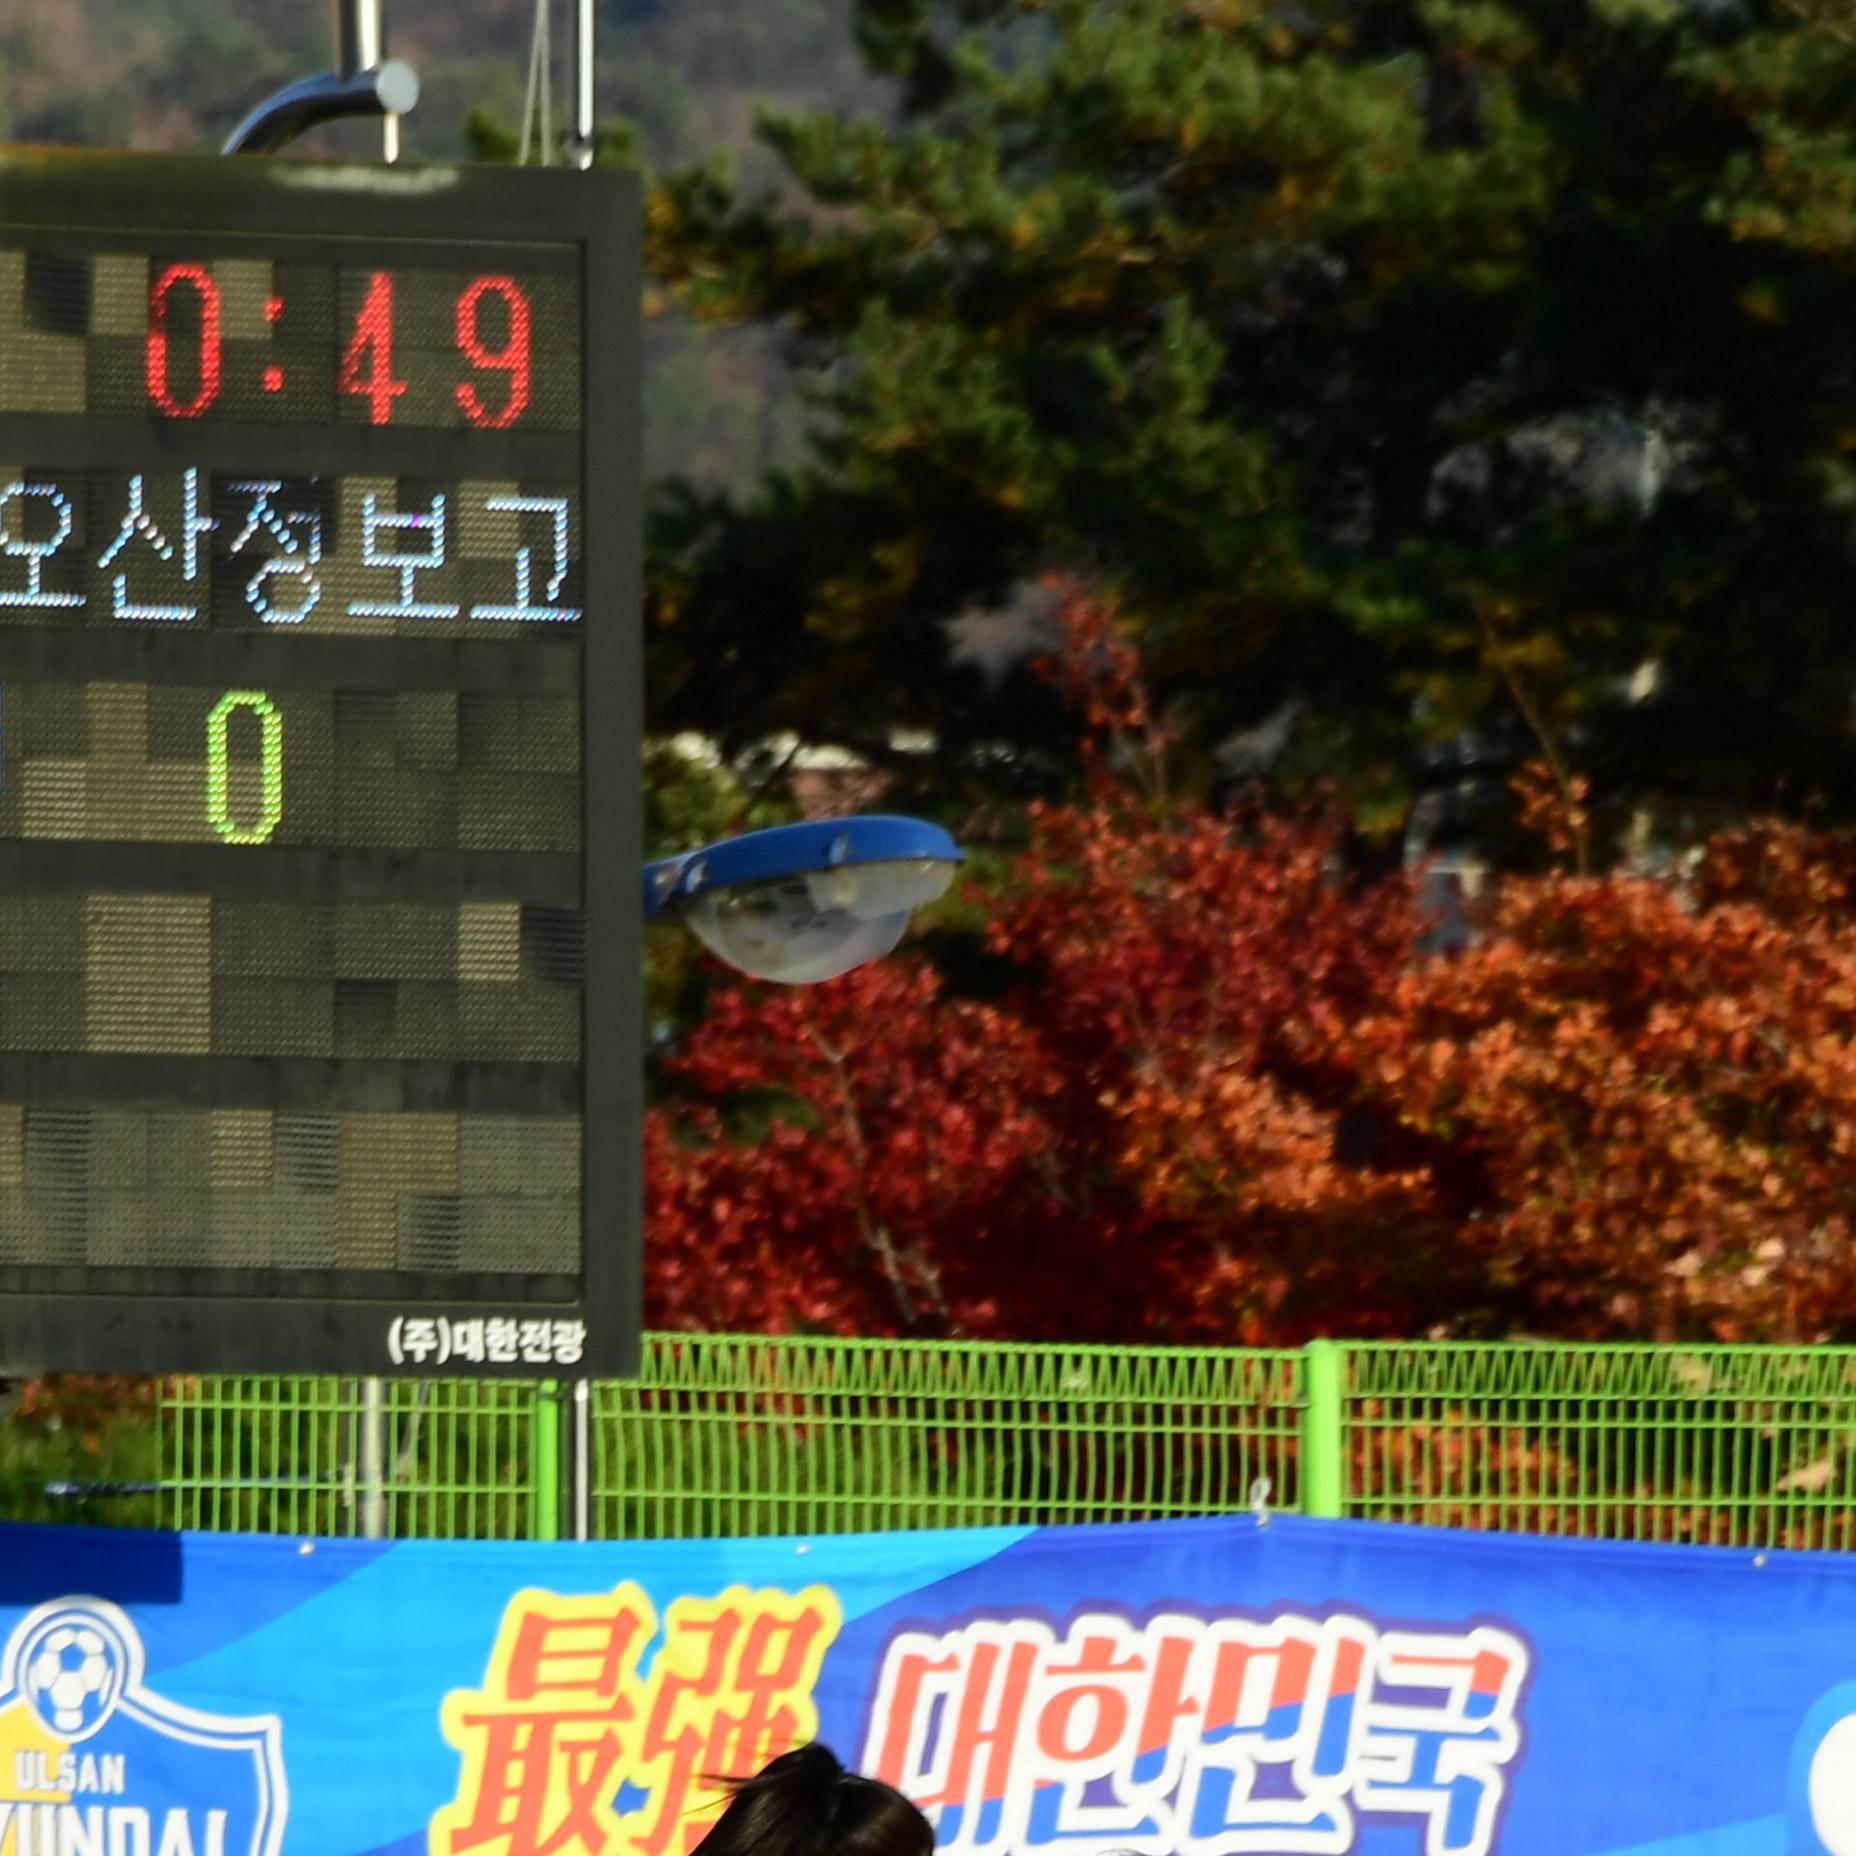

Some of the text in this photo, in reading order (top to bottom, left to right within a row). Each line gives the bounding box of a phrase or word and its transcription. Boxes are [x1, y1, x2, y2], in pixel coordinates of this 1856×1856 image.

[146, 262, 531, 428] 0:49
[204, 689, 284, 846] 0
[387, 1315, 588, 1366] (주)대한전광
[14, 1749, 126, 1795] ULSAN
